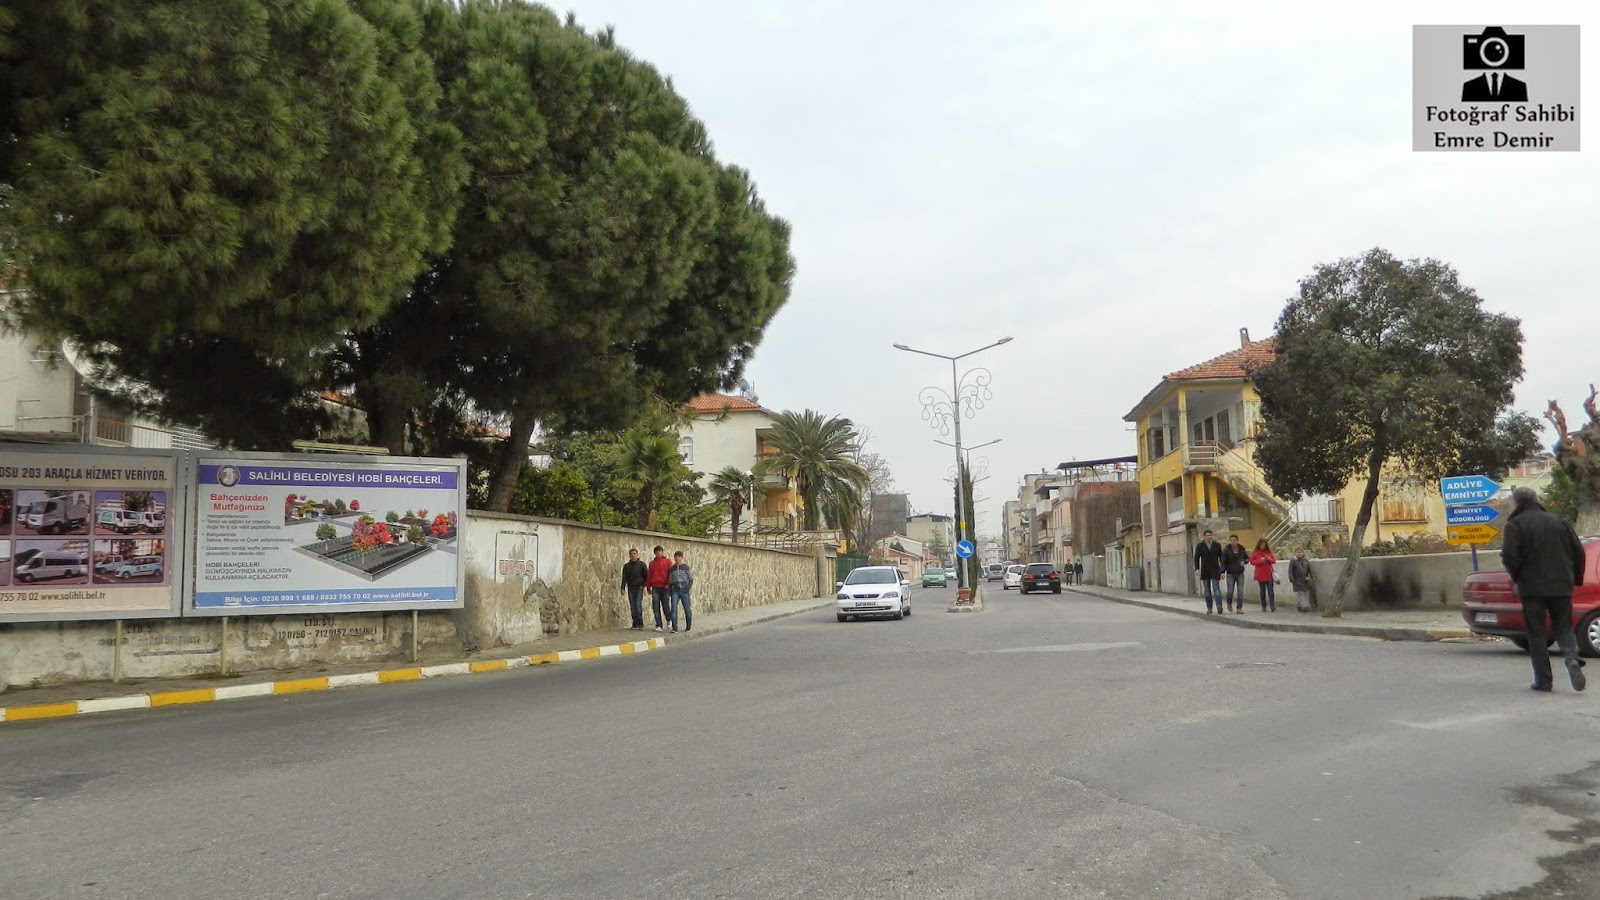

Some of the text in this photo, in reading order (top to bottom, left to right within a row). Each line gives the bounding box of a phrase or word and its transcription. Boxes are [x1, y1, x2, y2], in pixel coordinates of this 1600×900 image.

[22, 467, 41, 478] 203
[45, 468, 82, 482] ARAÇLA
[86, 466, 122, 480] HİZMET
[125, 467, 168, 481] VERİYOR.
[249, 470, 291, 480] SALİHLİ
[293, 472, 355, 482] BELEDİYESİ
[358, 472, 383, 483] HOBİ
[385, 474, 443, 486] BAHÇELERİ.
[1446, 480, 1482, 490] ADLİYE
[210, 493, 268, 502] Bahçenizden
[1444, 490, 1490, 500] EMNİYET
[213, 503, 265, 512] Mutfağınıza
[0, 591, 106, 602] 755 70 02 www.salihli.bel.tr
